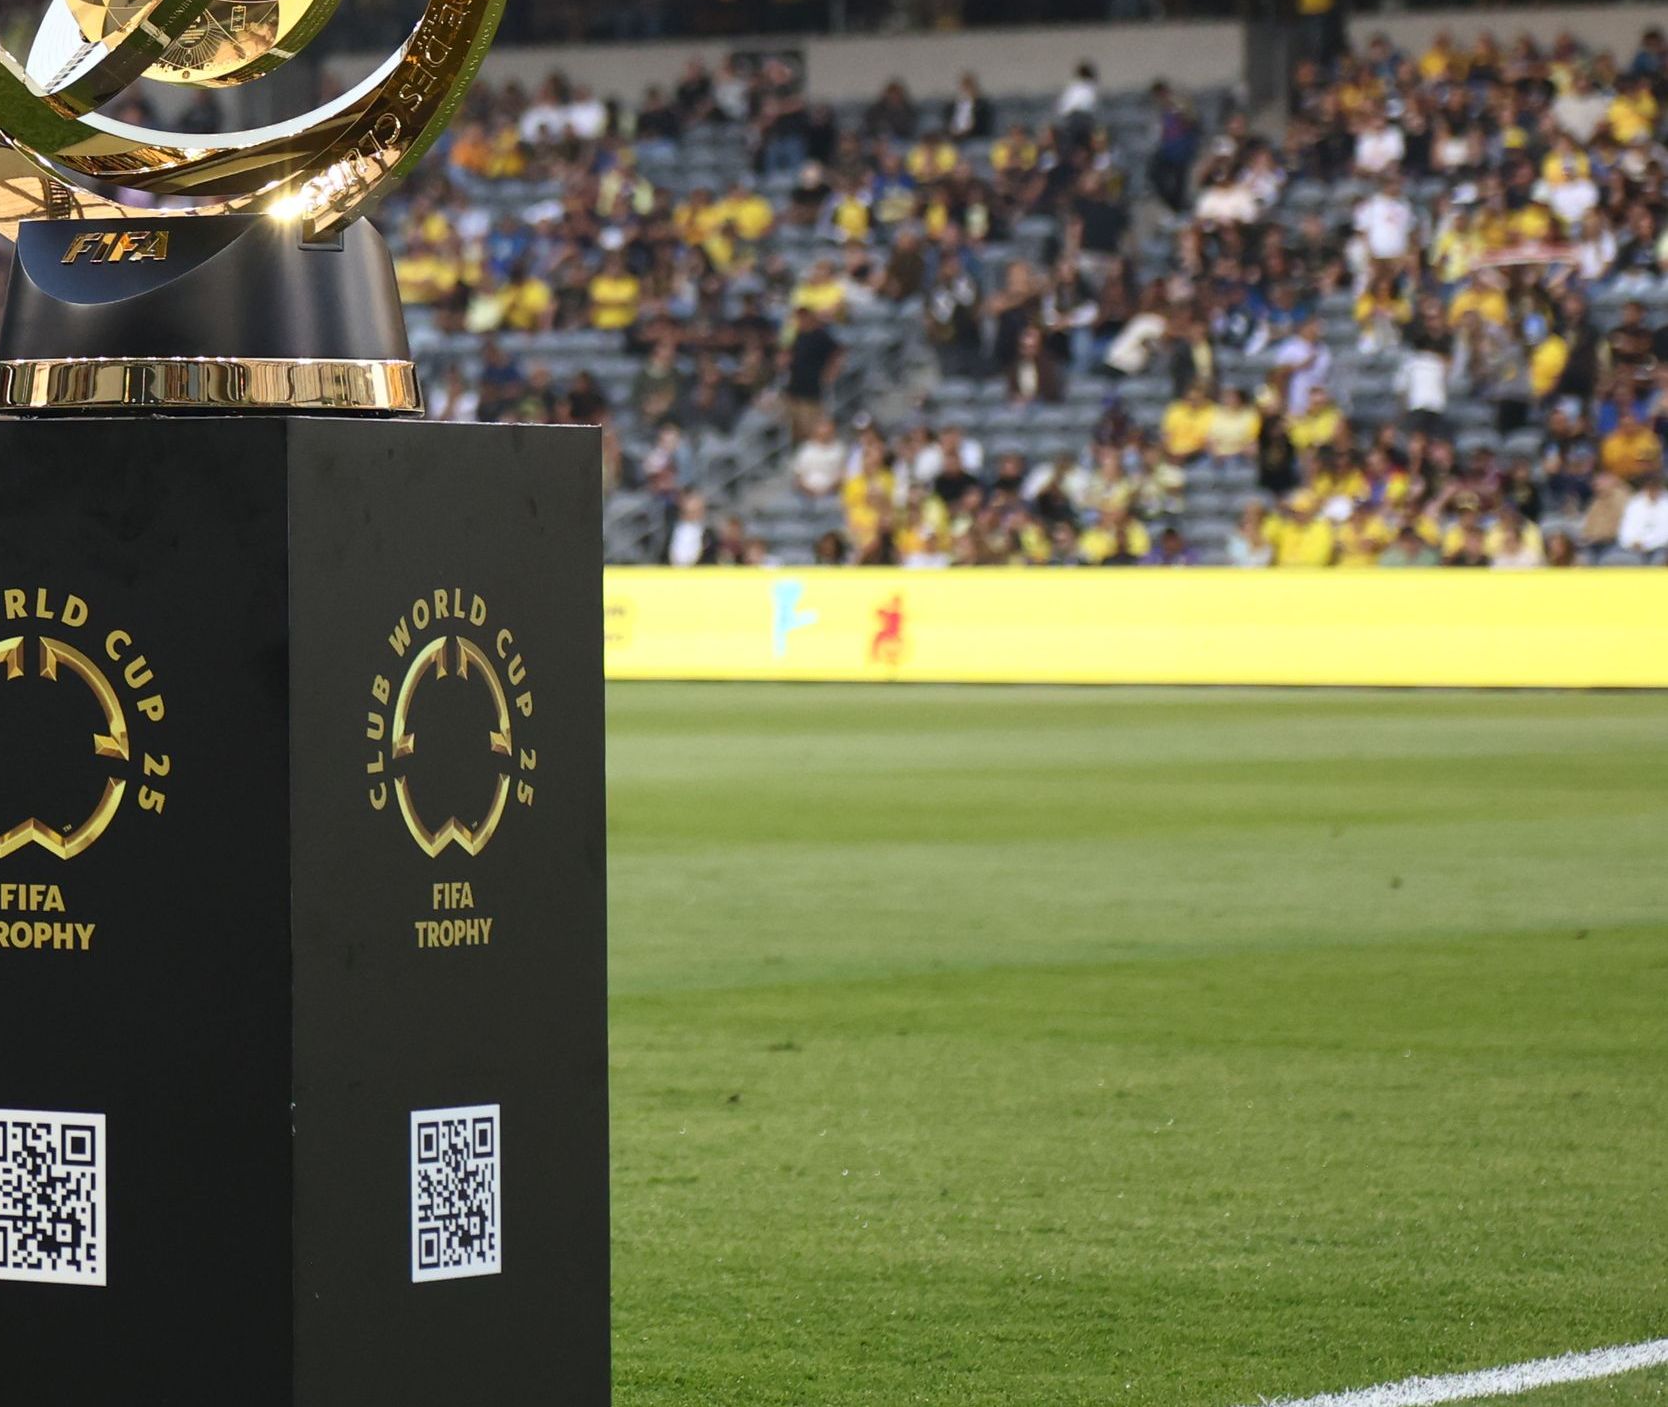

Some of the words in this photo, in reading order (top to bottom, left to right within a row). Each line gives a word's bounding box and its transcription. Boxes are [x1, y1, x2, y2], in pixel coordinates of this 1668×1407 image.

[60, 231, 169, 262] FIFA
[366, 674, 390, 810] CLUB
[388, 588, 487, 657] WORLD
[496, 628, 533, 718] CUP
[517, 748, 537, 807] 25
[105, 629, 165, 723] CUP
[138, 752, 171, 815] 25
[0, 883, 66, 912] FIFA
[433, 882, 474, 910] FIFA
[415, 918, 493, 948] TROPHY
